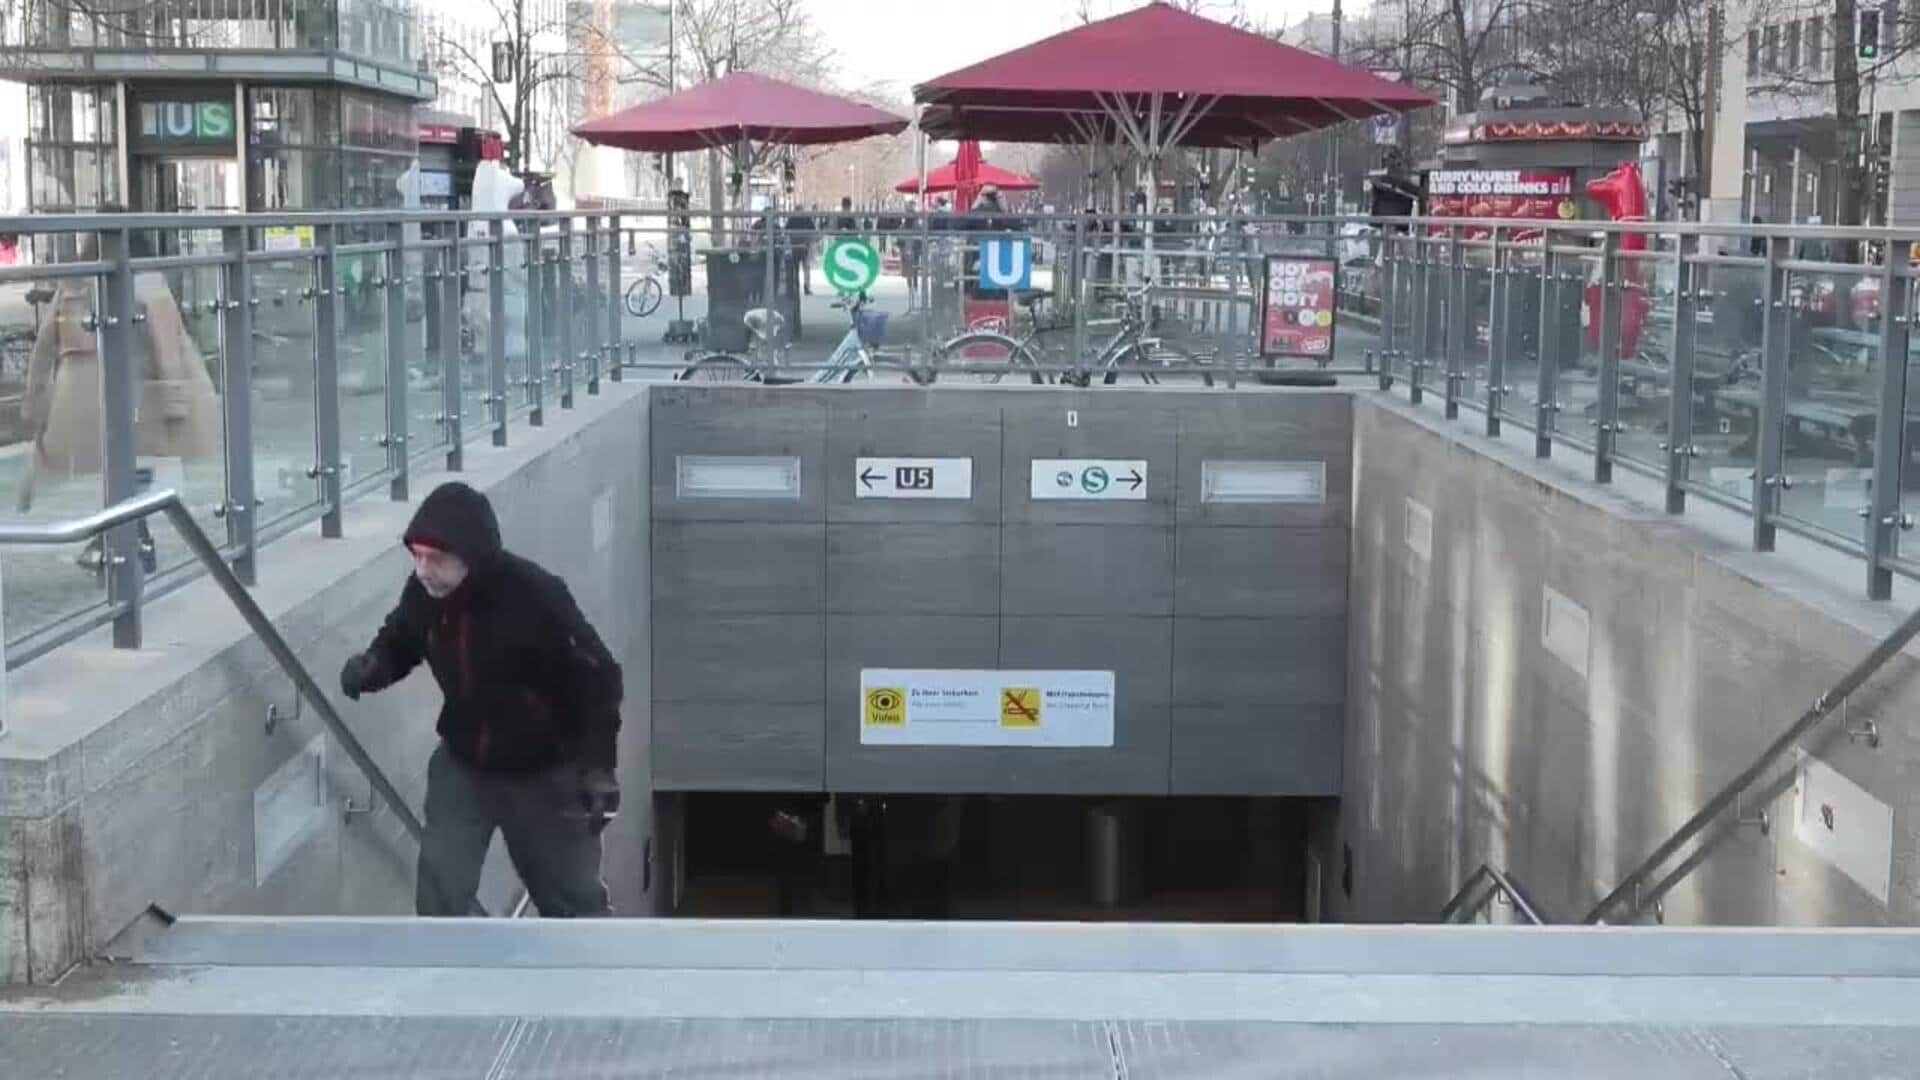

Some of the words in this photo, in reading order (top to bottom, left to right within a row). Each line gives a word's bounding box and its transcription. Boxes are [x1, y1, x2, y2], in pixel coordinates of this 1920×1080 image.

[1429, 169, 1521, 182] CURRYWURST
[1429, 181, 1456, 194] AND
[1457, 181, 1492, 194] COLD
[1493, 181, 1550, 194] DRINKS
[831, 240, 873, 290] S
[986, 239, 1026, 286] U
[897, 467, 933, 489] U5
[1083, 467, 1107, 493] S
[871, 713, 901, 722] Video
